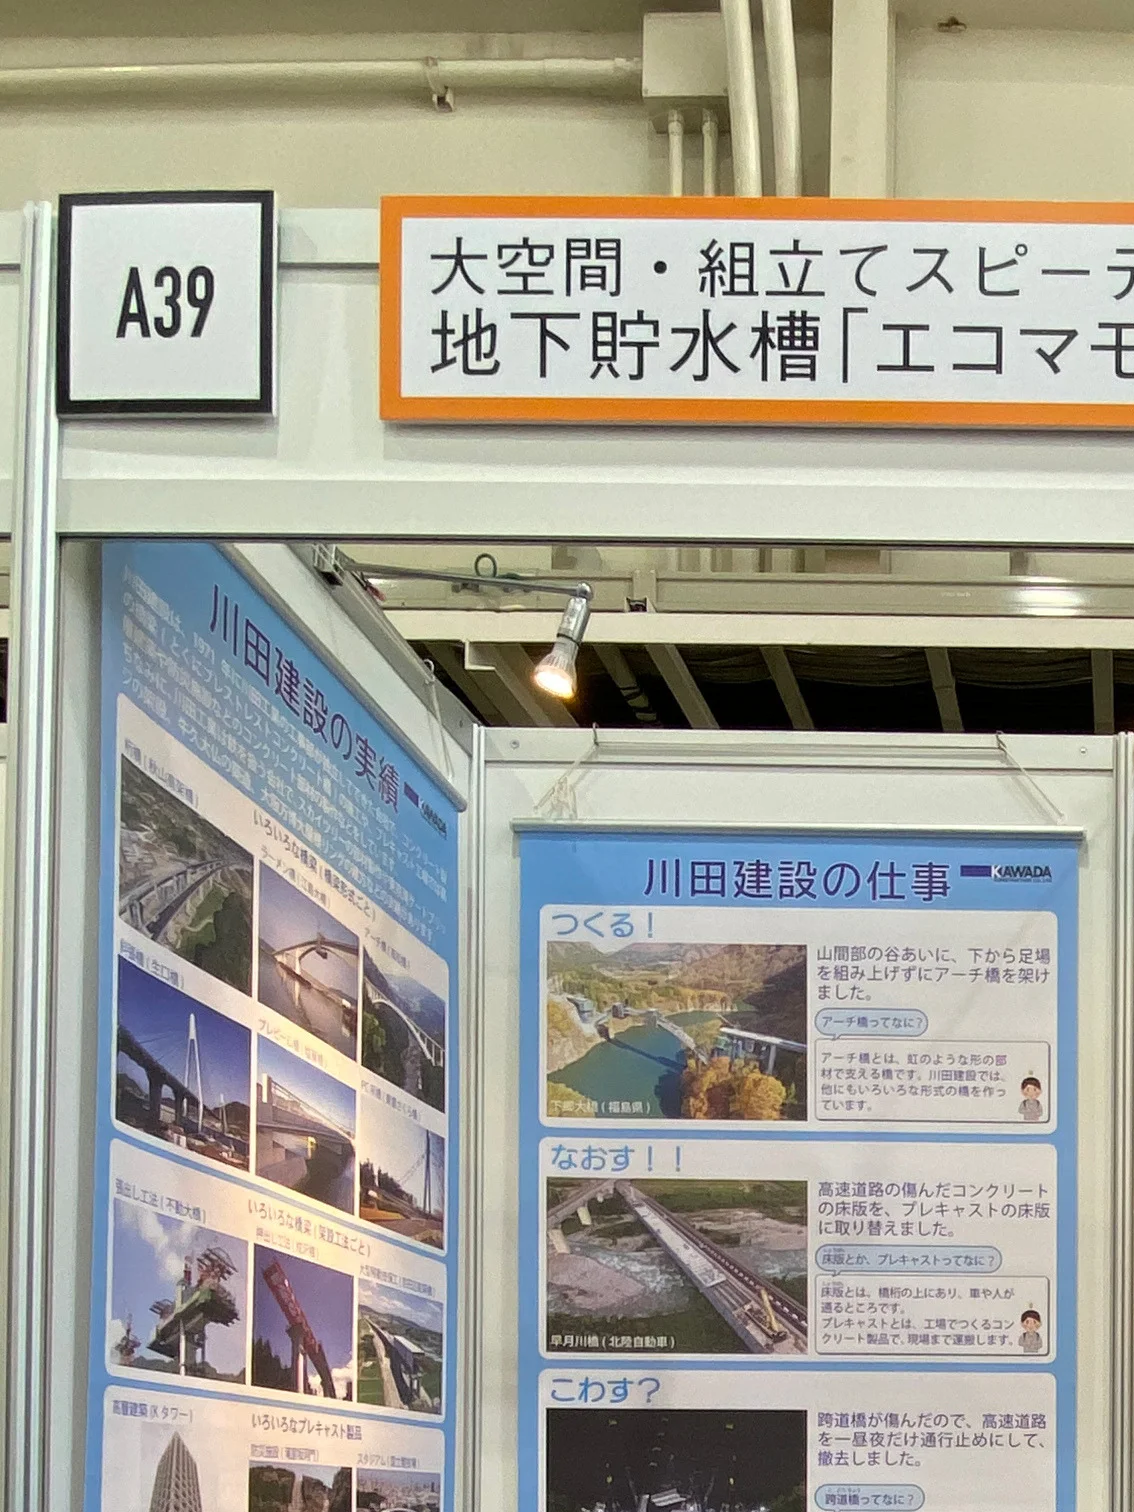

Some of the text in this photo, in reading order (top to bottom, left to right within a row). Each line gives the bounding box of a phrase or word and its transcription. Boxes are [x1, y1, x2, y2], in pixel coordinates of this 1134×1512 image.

[115, 264, 215, 339] A39
[209, 584, 400, 813] 川田建設の実績
[643, 858, 951, 901] 川田建設の仕事
[992, 865, 1052, 877] KAWADA
[551, 912, 655, 938] つくる！
[817, 945, 1050, 965] 山間部の谷あいに、下から足場
[817, 964, 1050, 984] を組み上げずにアーチ橋を架け
[818, 984, 873, 1001] ました。
[822, 1099, 873, 1111] ています。
[818, 1182, 1049, 1200] 高速道路の傷んだコンクリート
[818, 1202, 1051, 1219] の床版を、プレキャストの床版
[818, 1220, 957, 1238] に取り替えました。
[821, 1301, 905, 1315] 通るところです。
[821, 1317, 1015, 1331] プレキャストとは、工場でつくるコン
[550, 1377, 662, 1403] こわす？
[818, 1412, 1047, 1430] 跨道橋が傷んだので、高速道路
[818, 1431, 1047, 1449] を一昼夜だけ通行止めにして、
[818, 1450, 924, 1468] 撤去しました。
